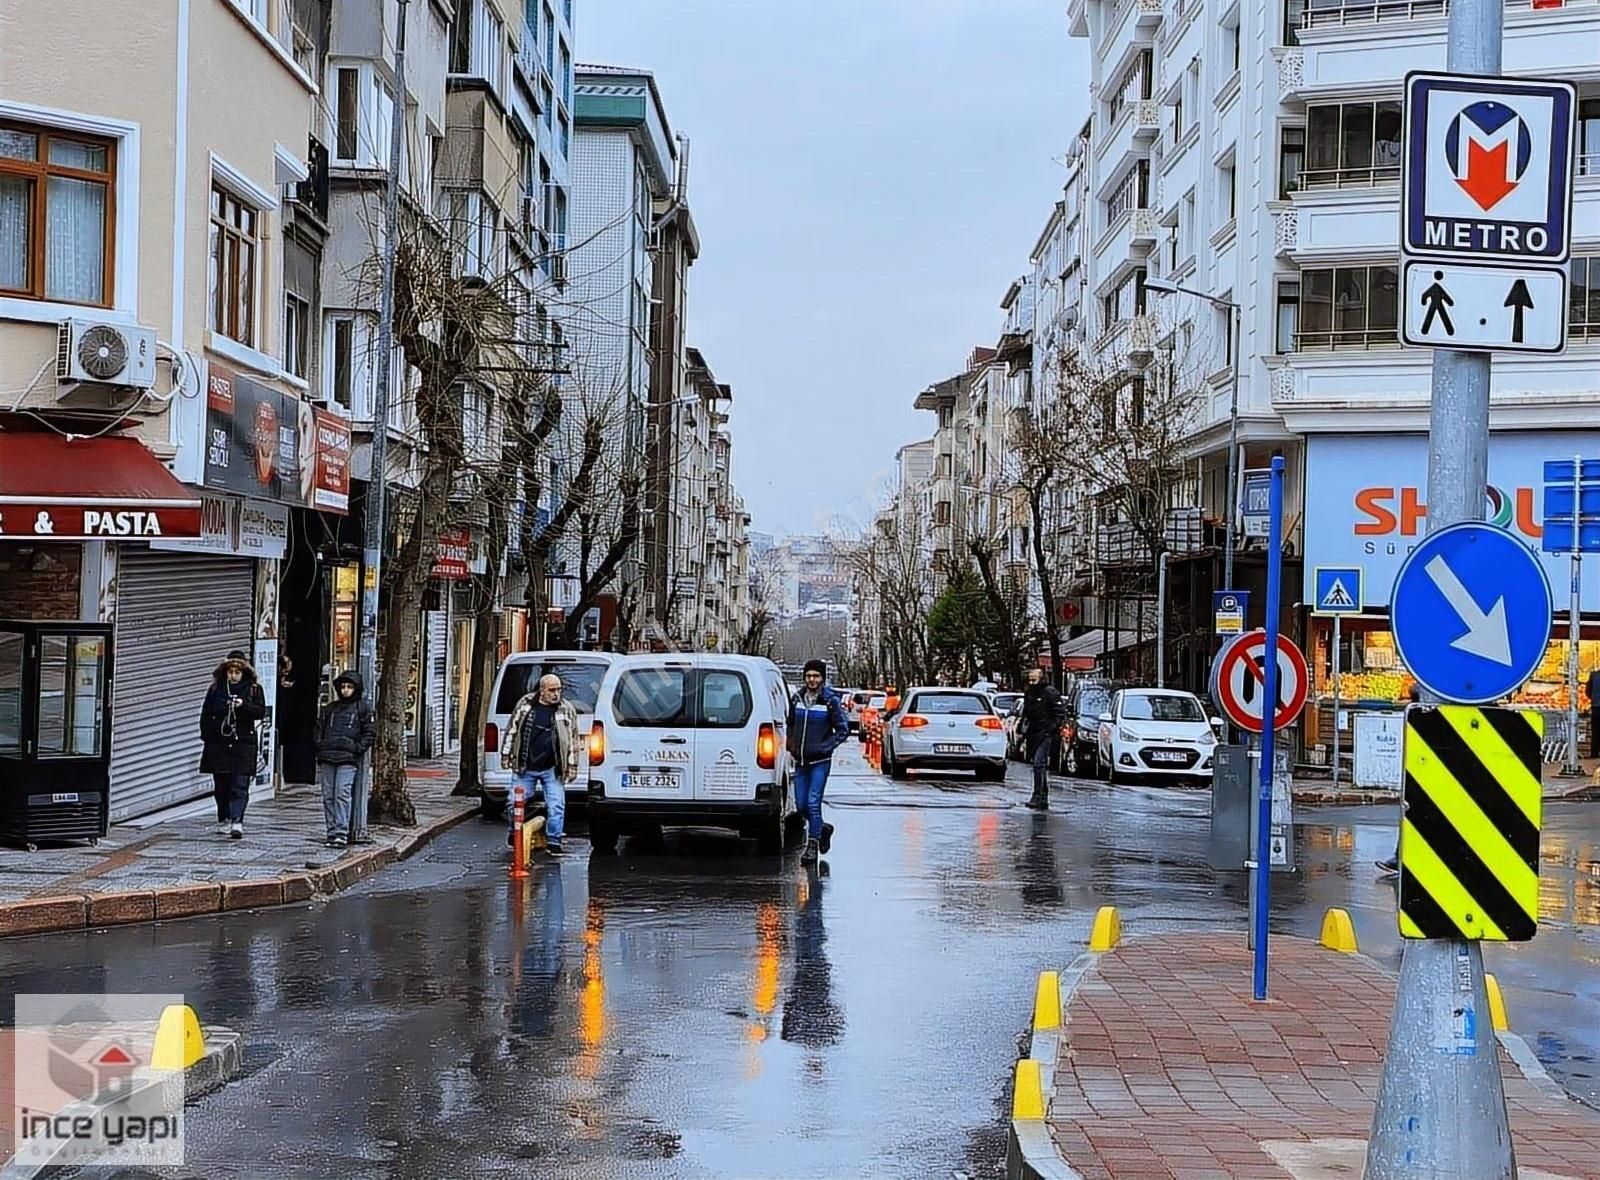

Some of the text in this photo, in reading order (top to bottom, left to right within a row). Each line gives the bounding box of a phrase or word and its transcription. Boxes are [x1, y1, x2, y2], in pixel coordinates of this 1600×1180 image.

[1425, 221, 1548, 251] METRO
[84, 511, 162, 535] PASTA
[627, 775, 638, 785] 34
[640, 775, 651, 786] UE
